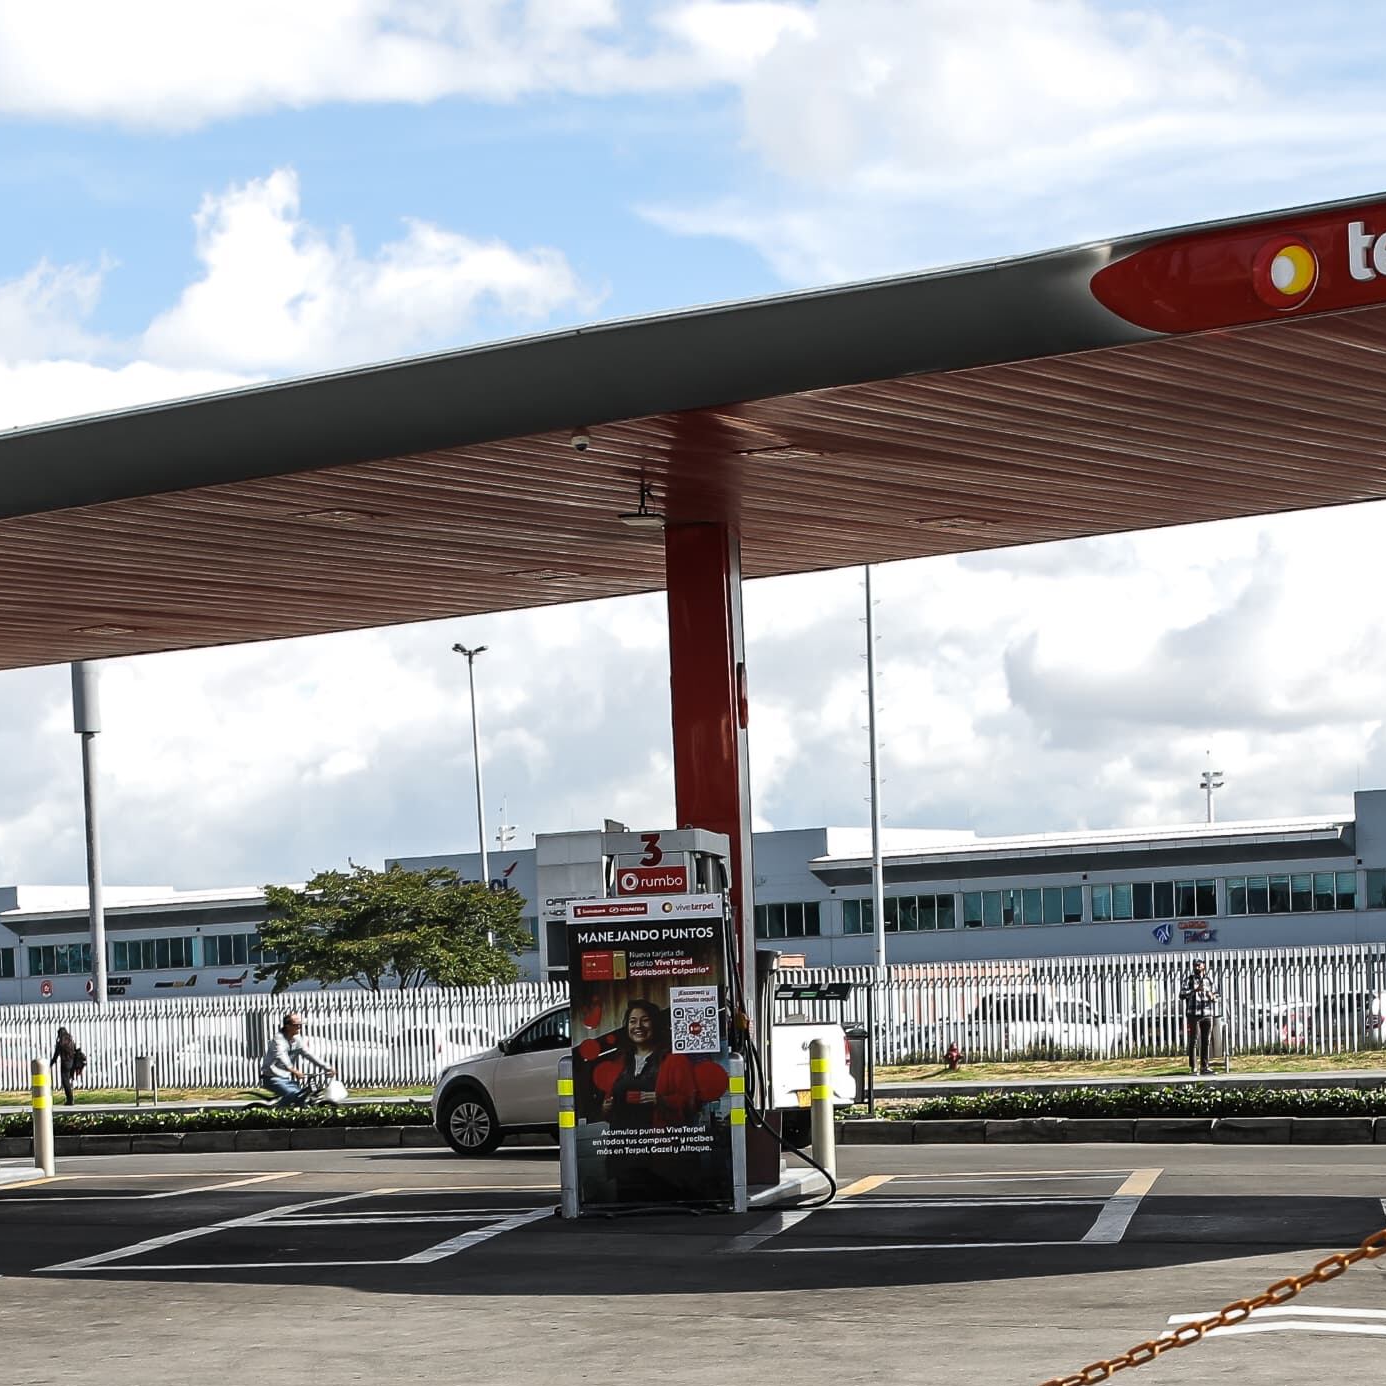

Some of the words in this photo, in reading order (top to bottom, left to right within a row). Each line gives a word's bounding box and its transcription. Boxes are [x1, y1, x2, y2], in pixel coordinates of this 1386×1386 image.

[639, 833, 663, 867] 3
[641, 875, 683, 888] rumbo
[578, 929, 660, 944] MANEJANDO
[662, 927, 714, 940] PUNTOS
[629, 951, 651, 959] Nueva
[652, 950, 674, 959] tarjeta
[675, 949, 684, 957] de
[629, 959, 654, 967] crédito
[654, 958, 693, 968] ViveTerpel
[630, 968, 671, 977] Scotiabank
[601, 1128, 638, 1136] Acumulas
[639, 1127, 665, 1136] puntos
[666, 1125, 706, 1135] ViveTerpel
[603, 1137, 625, 1145] todas
[596, 1147, 613, 1155] más
[624, 1146, 650, 1156] Terpel,
[650, 1145, 673, 1153] Gazel
[680, 1144, 712, 1154] Altoque.
